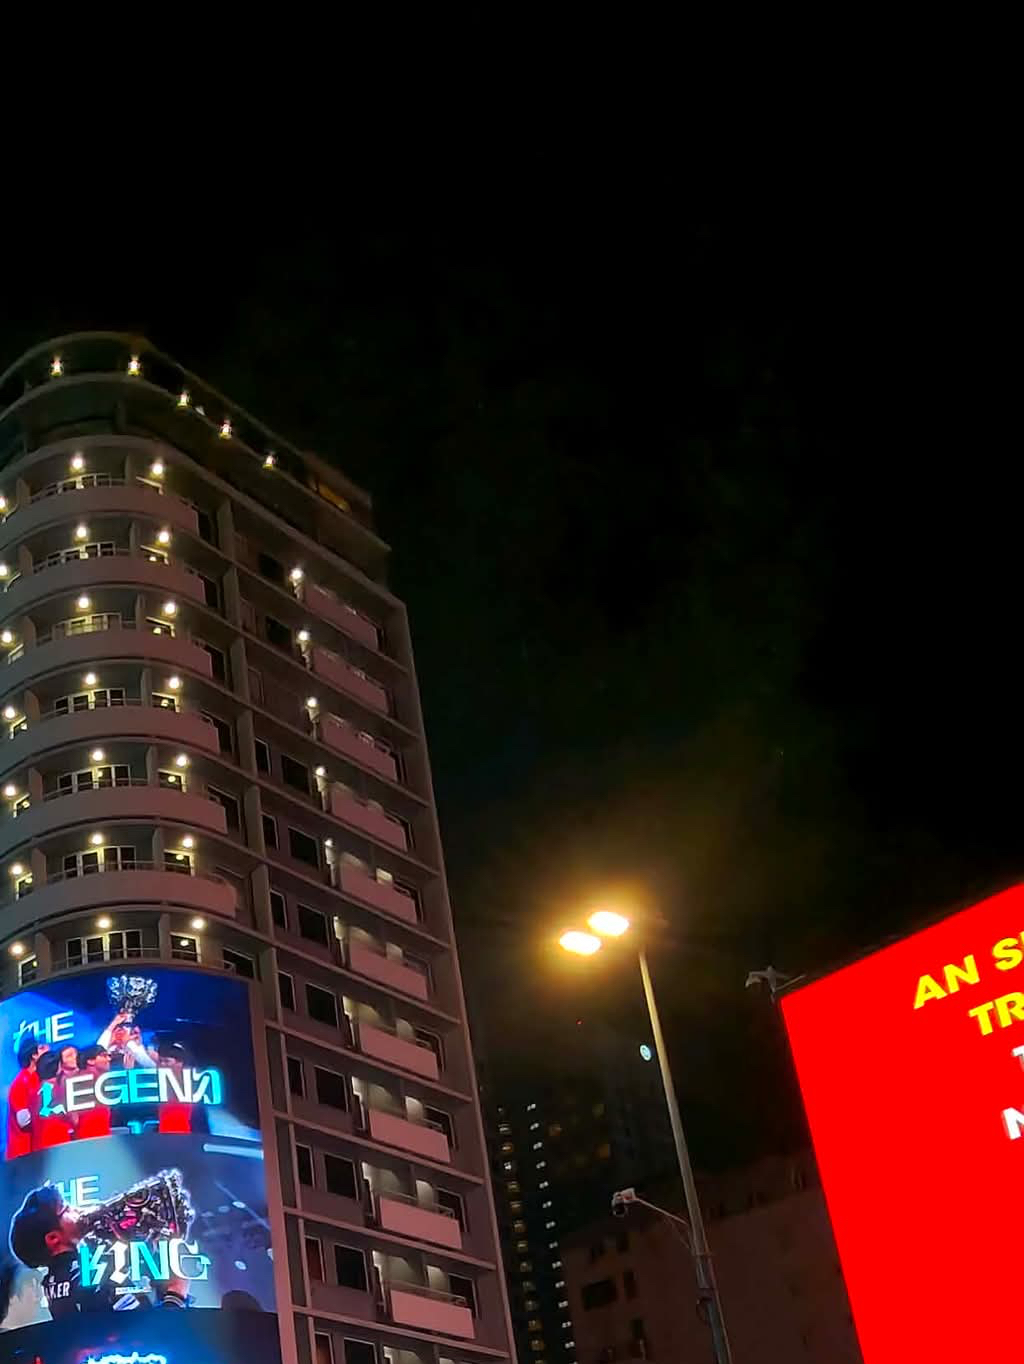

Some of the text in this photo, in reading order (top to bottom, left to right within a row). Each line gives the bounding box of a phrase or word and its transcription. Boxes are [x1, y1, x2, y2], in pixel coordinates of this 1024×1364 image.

[913, 954, 980, 1010] AN
[37, 1066, 222, 1118] LEGEND
[78, 1237, 212, 1288] KING
